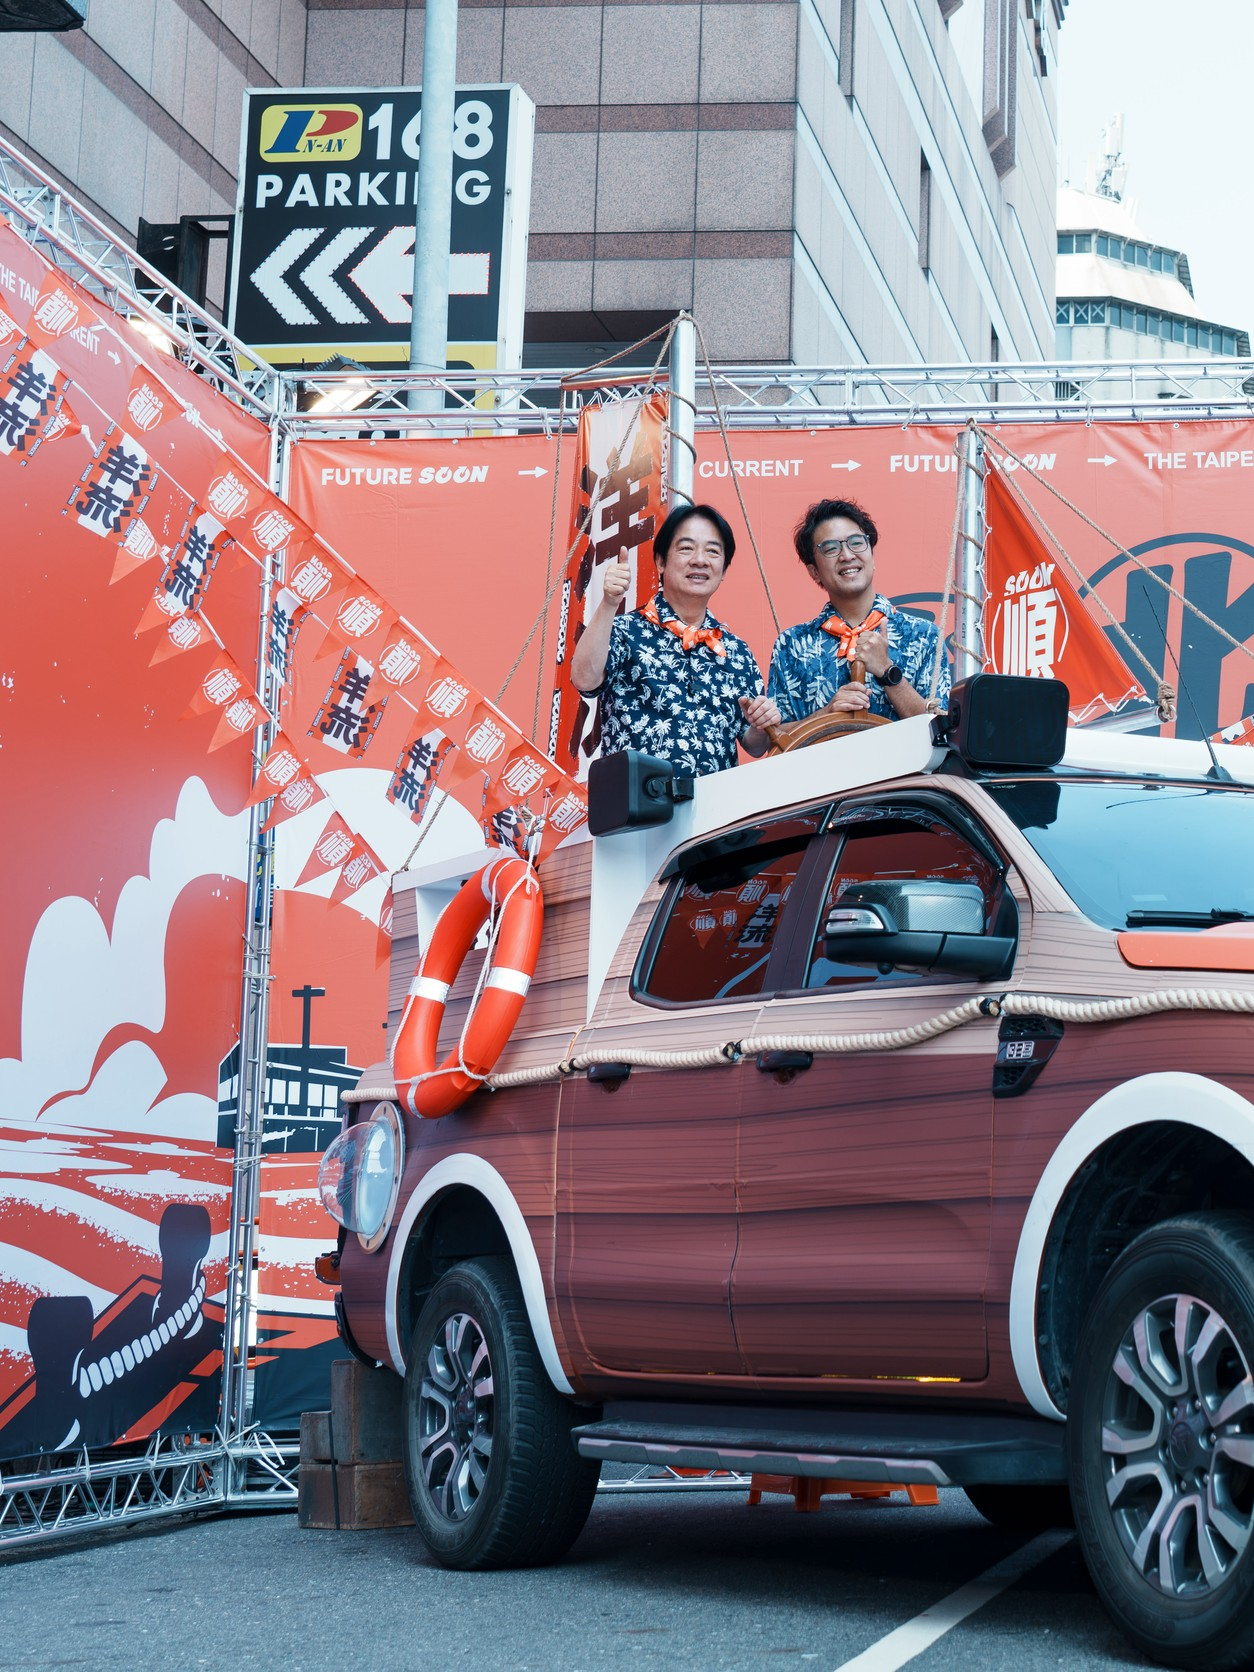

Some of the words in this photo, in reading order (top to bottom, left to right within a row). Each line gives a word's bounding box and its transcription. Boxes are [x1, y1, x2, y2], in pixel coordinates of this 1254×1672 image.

[255, 169, 492, 208] PARKIG
[0, 264, 16, 293] HE
[19, 276, 39, 308] TAI
[70, 325, 100, 355] RENT
[699, 460, 803, 478] CURRENT
[890, 455, 957, 473] FUTU
[1144, 452, 1186, 470] THE
[321, 468, 412, 486] FUTURE
[419, 466, 489, 484] SOON
[1004, 561, 1056, 597] SOON
[1002, 588, 1057, 679] 順
